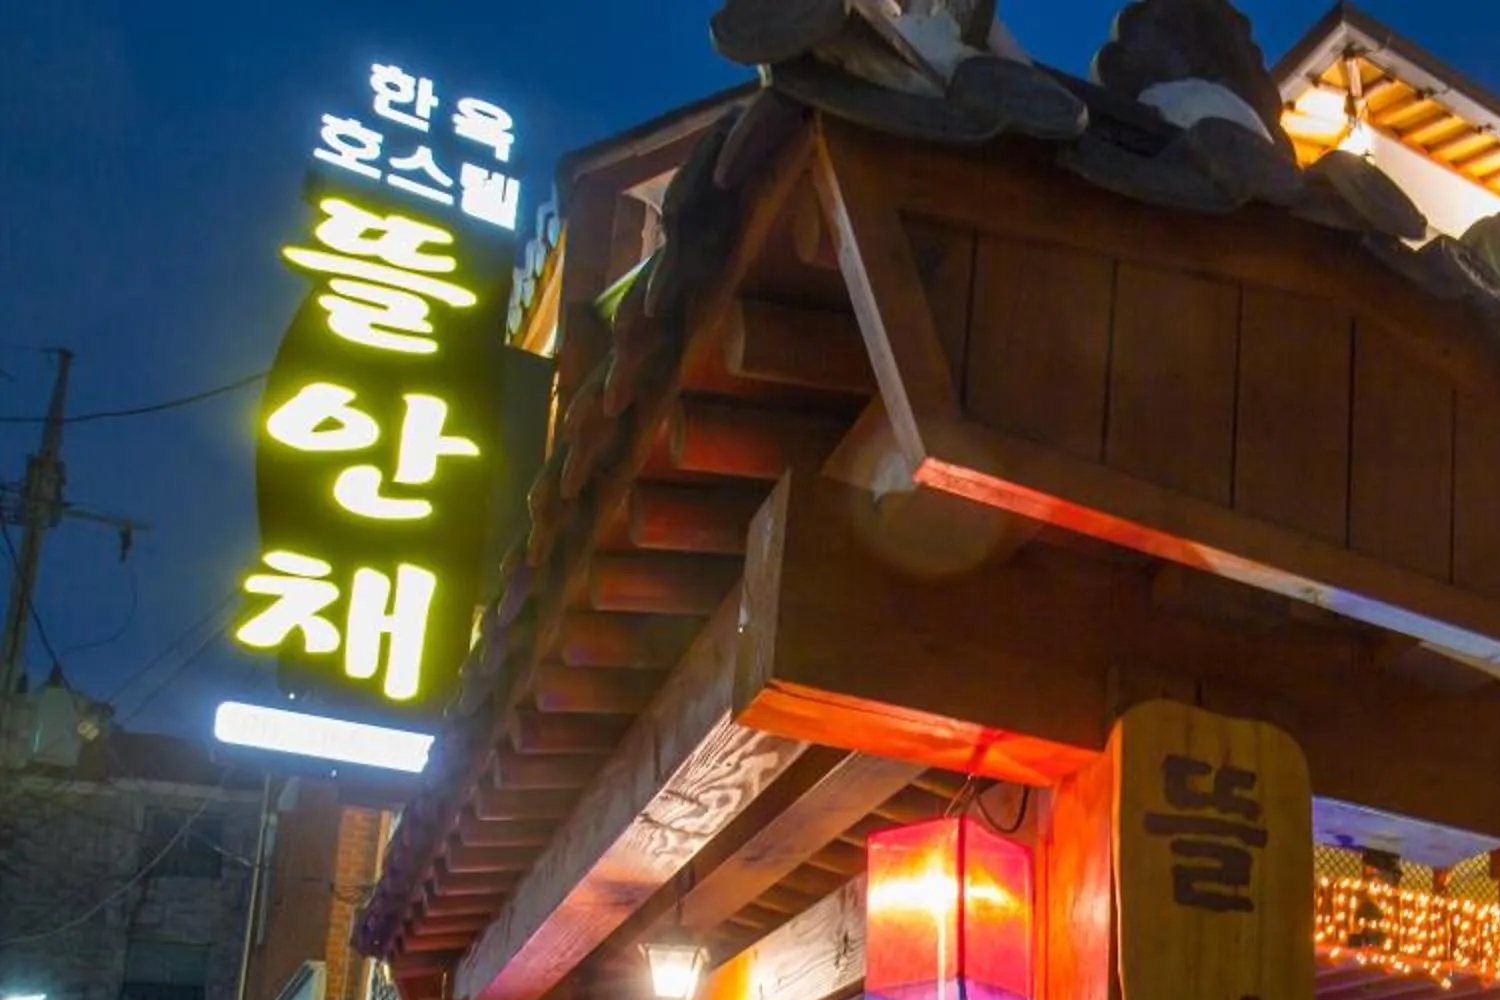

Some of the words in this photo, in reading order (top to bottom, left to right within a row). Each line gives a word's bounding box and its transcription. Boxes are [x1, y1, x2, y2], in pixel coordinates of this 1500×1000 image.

[369, 63, 515, 162] 한옥
[312, 113, 520, 231] 호스텔
[236, 198, 481, 700] 뜰안채
